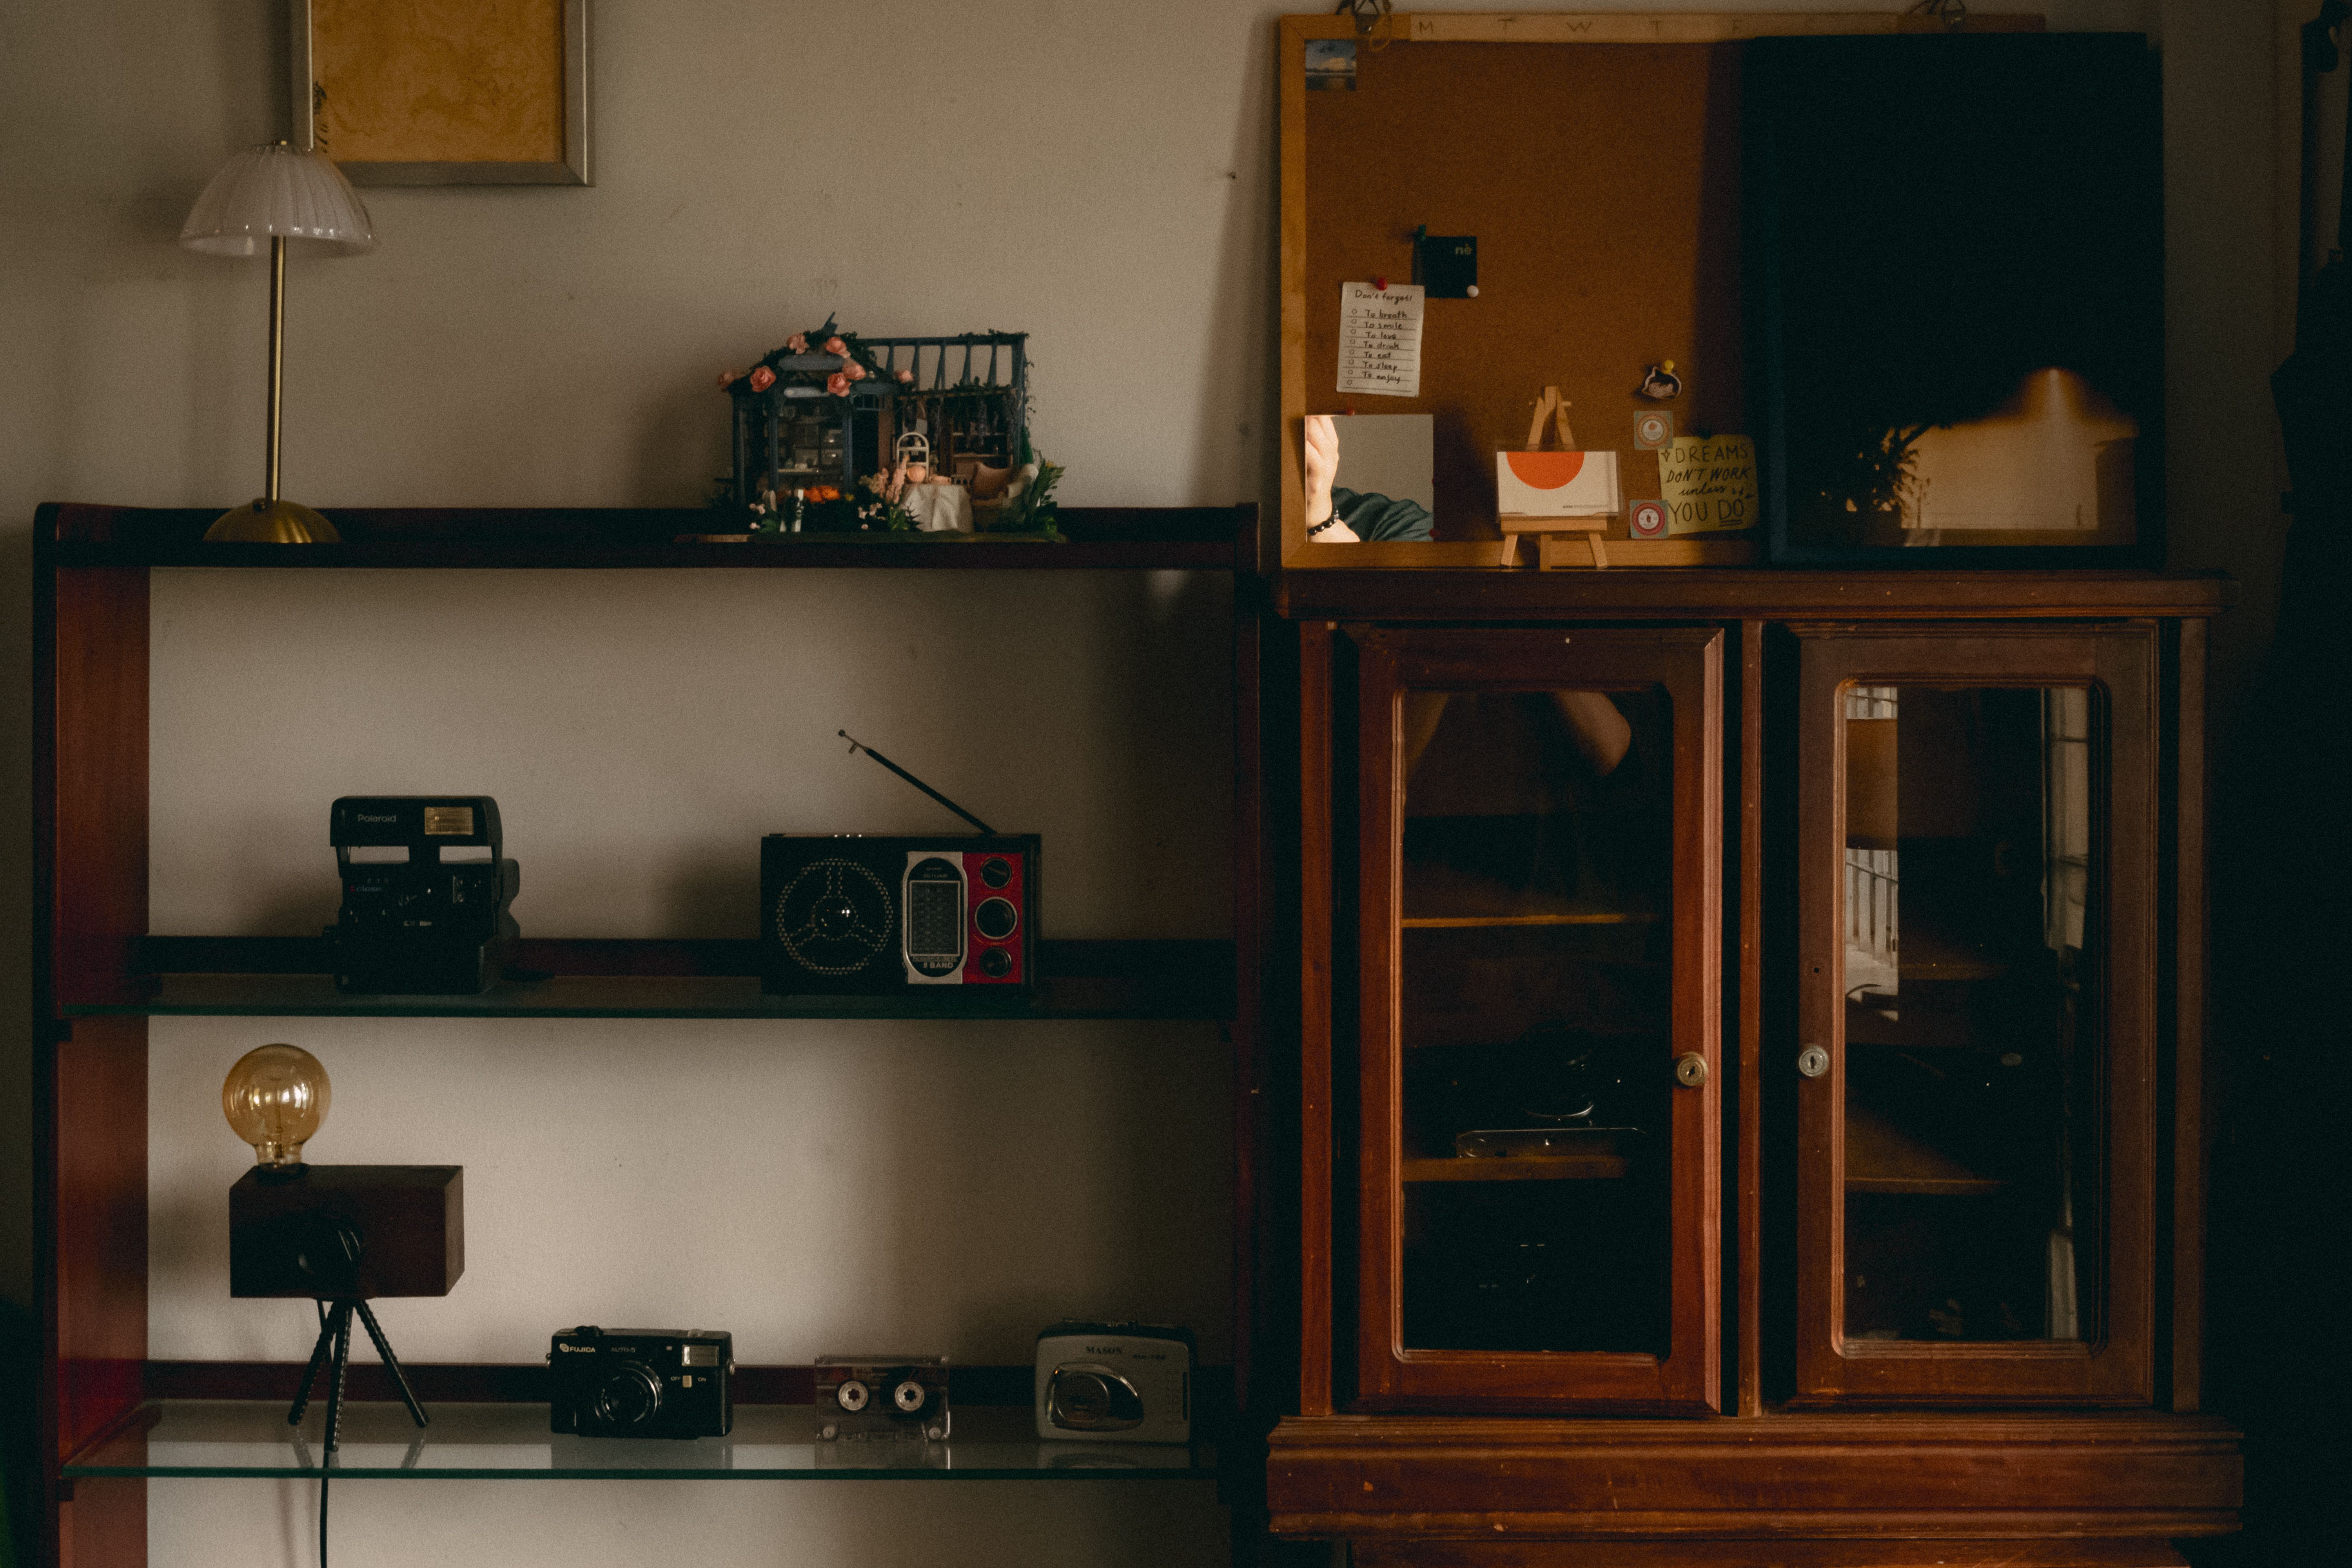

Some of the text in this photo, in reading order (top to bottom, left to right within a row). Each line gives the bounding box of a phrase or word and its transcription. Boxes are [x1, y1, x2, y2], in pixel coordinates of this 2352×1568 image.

[1419, 21, 1434, 34] M
[1567, 22, 1593, 33] W
[1649, 20, 1662, 34] T
[1355, 289, 1412, 305] Don't forget!
[1365, 309, 1407, 318] To breath
[1376, 362, 1397, 373] sleep
[1376, 374, 1400, 384] enjoy
[1675, 444, 1748, 463] DREAMS
[1666, 466, 1751, 483] DON'T WORK
[1679, 483, 1726, 496] unless
[1669, 502, 1708, 524] YOU
[1718, 498, 1744, 520] DO
[357, 814, 396, 823] Polaroid
